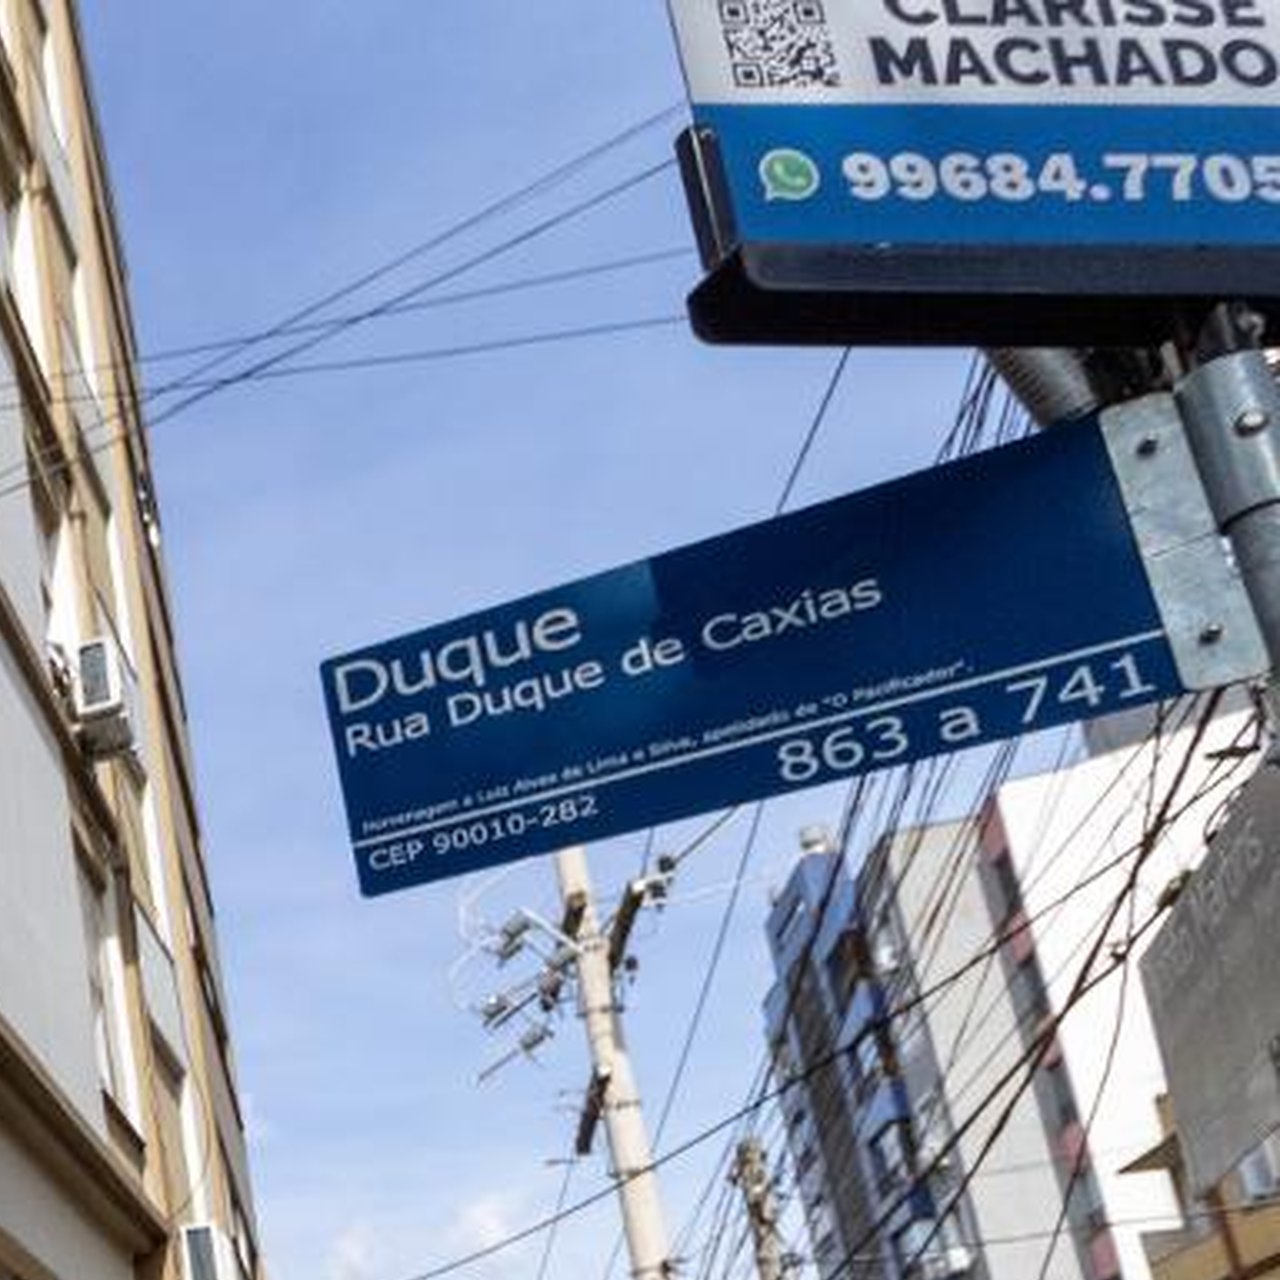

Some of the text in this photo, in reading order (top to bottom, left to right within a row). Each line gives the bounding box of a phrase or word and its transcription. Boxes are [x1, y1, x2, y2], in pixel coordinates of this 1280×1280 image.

[869, 36, 1278, 87] MACHADO
[842, 152, 1280, 201] 99684.7705
[334, 607, 581, 714] Duque
[345, 578, 883, 757] Rua Duque de Caxias
[777, 653, 1156, 782] 863 a 741
[368, 796, 599, 870] CEP 90010-282
